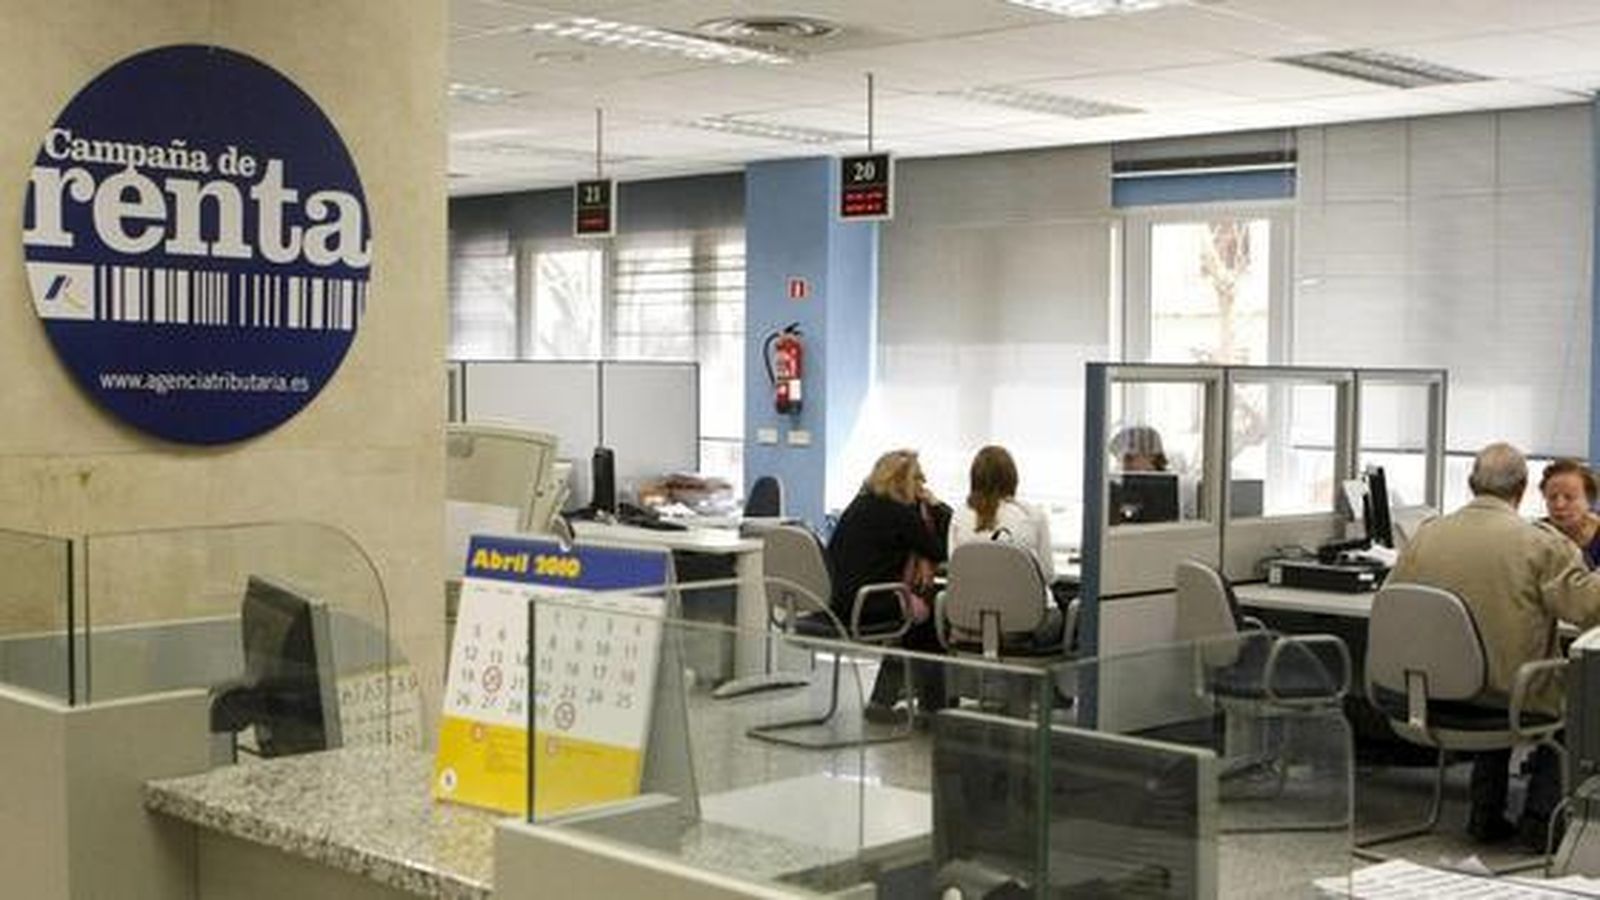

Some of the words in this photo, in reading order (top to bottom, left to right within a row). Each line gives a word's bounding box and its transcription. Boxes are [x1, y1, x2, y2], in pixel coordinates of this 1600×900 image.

[45, 127, 210, 175] Campaña
[218, 146, 257, 177] de
[853, 160, 876, 181] 20
[23, 158, 372, 268] renta
[100, 371, 309, 395] www.agenciatributaria.es
[473, 549, 528, 573] Abril
